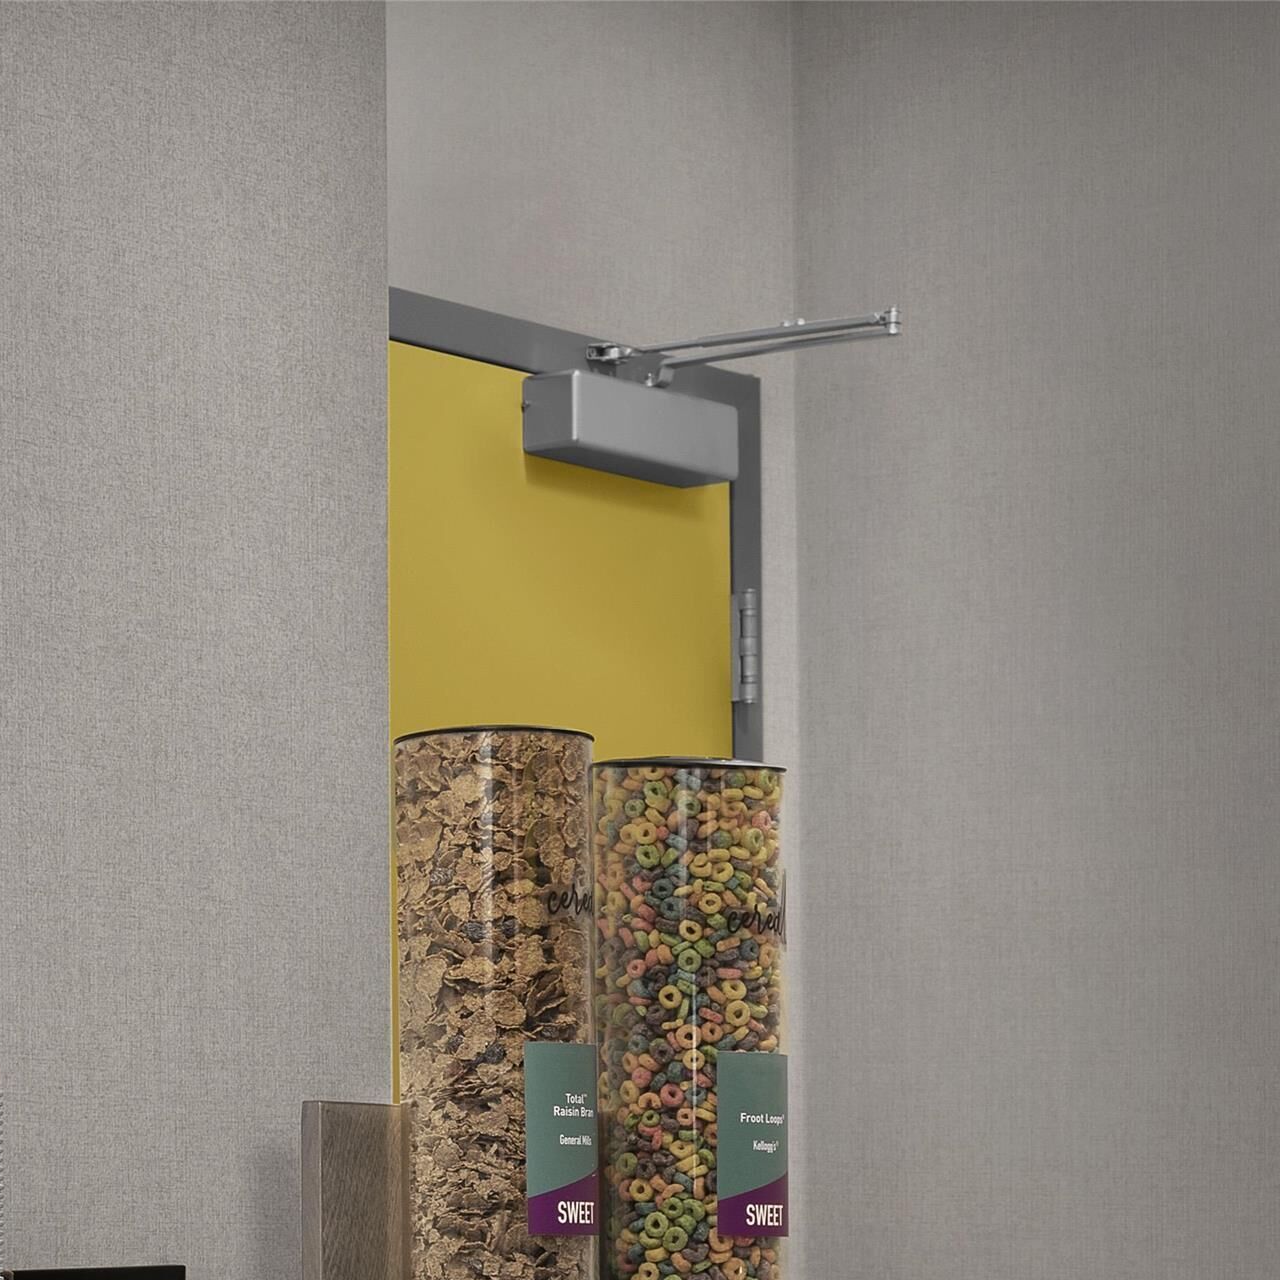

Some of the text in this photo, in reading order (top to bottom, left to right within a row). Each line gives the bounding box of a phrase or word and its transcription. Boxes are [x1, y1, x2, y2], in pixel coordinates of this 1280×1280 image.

[553, 1106, 580, 1117] Raisin
[740, 1112, 764, 1123] Froot
[558, 1201, 594, 1225] SWEET
[746, 1204, 783, 1227] SWEET
